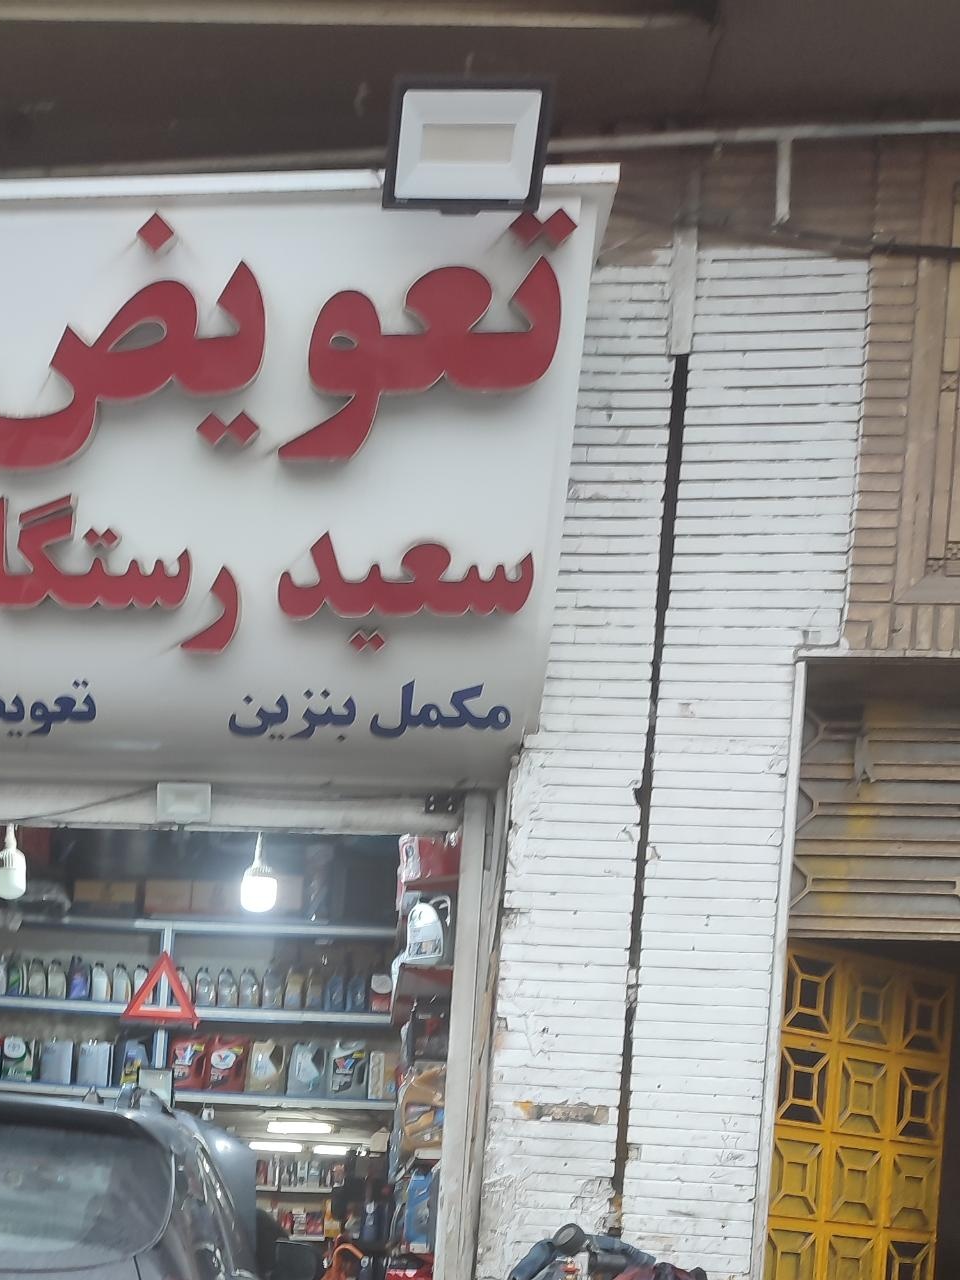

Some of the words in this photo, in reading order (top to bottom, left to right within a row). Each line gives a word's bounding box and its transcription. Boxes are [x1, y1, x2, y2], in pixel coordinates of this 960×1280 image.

[277, 530, 536, 652] سعید
[227, 687, 357, 741] بنزین
[369, 678, 513, 739] مکمل
